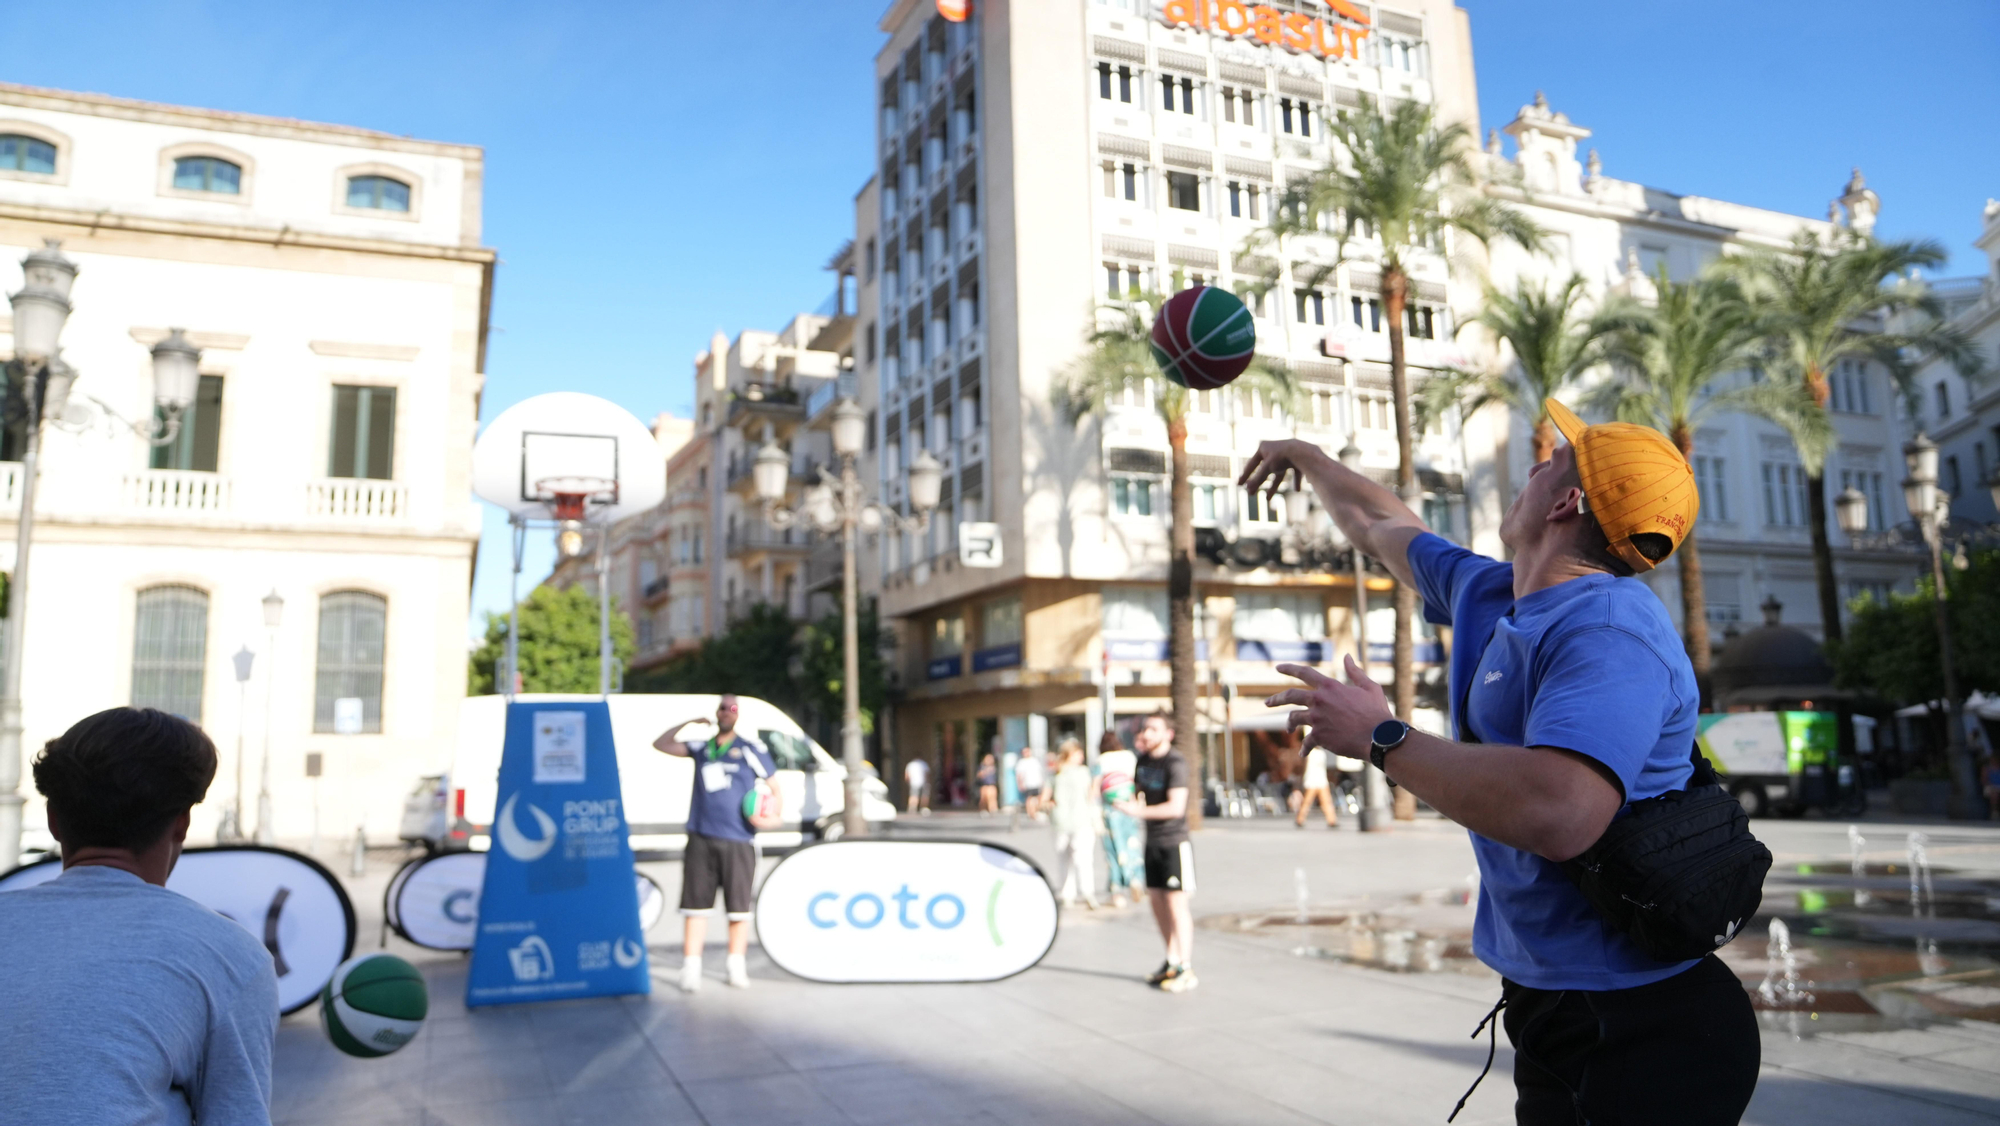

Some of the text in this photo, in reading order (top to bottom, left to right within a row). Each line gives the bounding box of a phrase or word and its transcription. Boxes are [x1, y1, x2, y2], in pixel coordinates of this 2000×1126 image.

[1163, 0, 1371, 60] albasur
[1673, 513, 1685, 527] SAN
[563, 799, 618, 817] PONT
[563, 816, 620, 833] GRUP
[806, 883, 966, 930] coto
